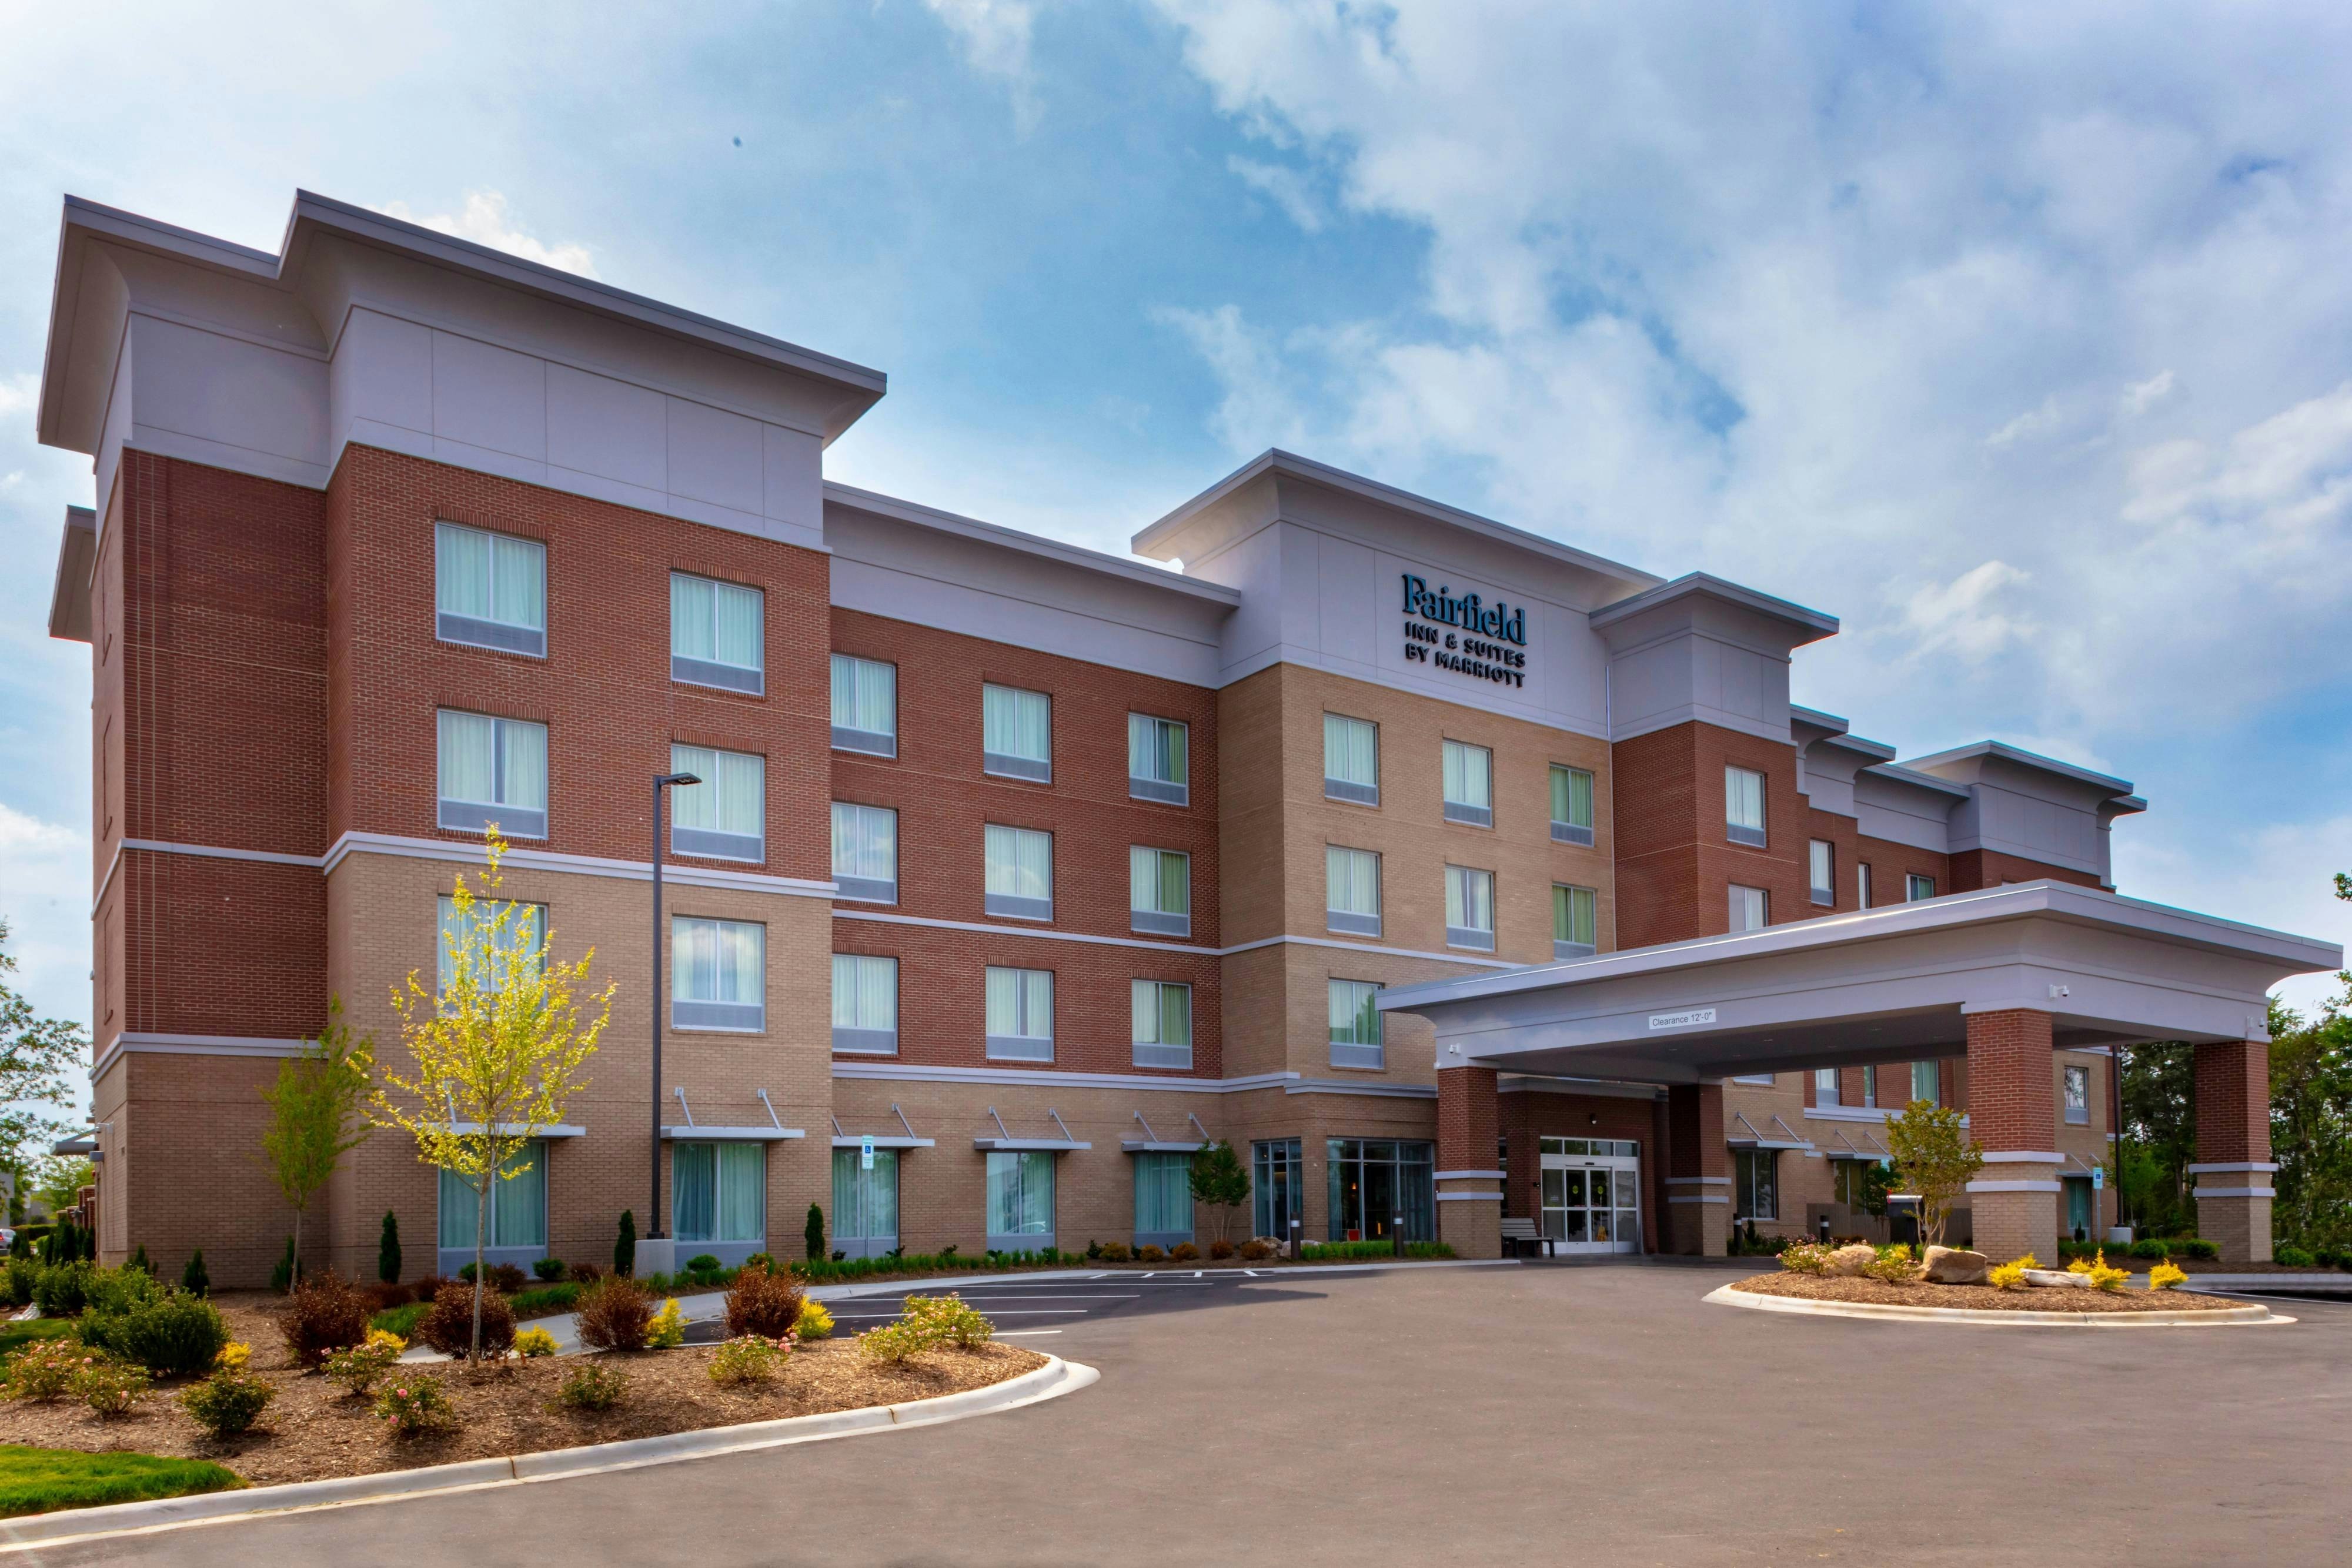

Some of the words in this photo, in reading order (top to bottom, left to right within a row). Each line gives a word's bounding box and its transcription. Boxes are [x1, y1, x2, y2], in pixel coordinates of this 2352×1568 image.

[1402, 574, 1527, 646] Fairfield
[1405, 621, 1439, 644] INN
[1445, 633, 1458, 649] &
[1464, 638, 1525, 668] SUITES
[1405, 643, 1430, 663] BY
[1435, 651, 1525, 688] MARRIOTT
[1652, 1016, 1688, 1026] Clearance
